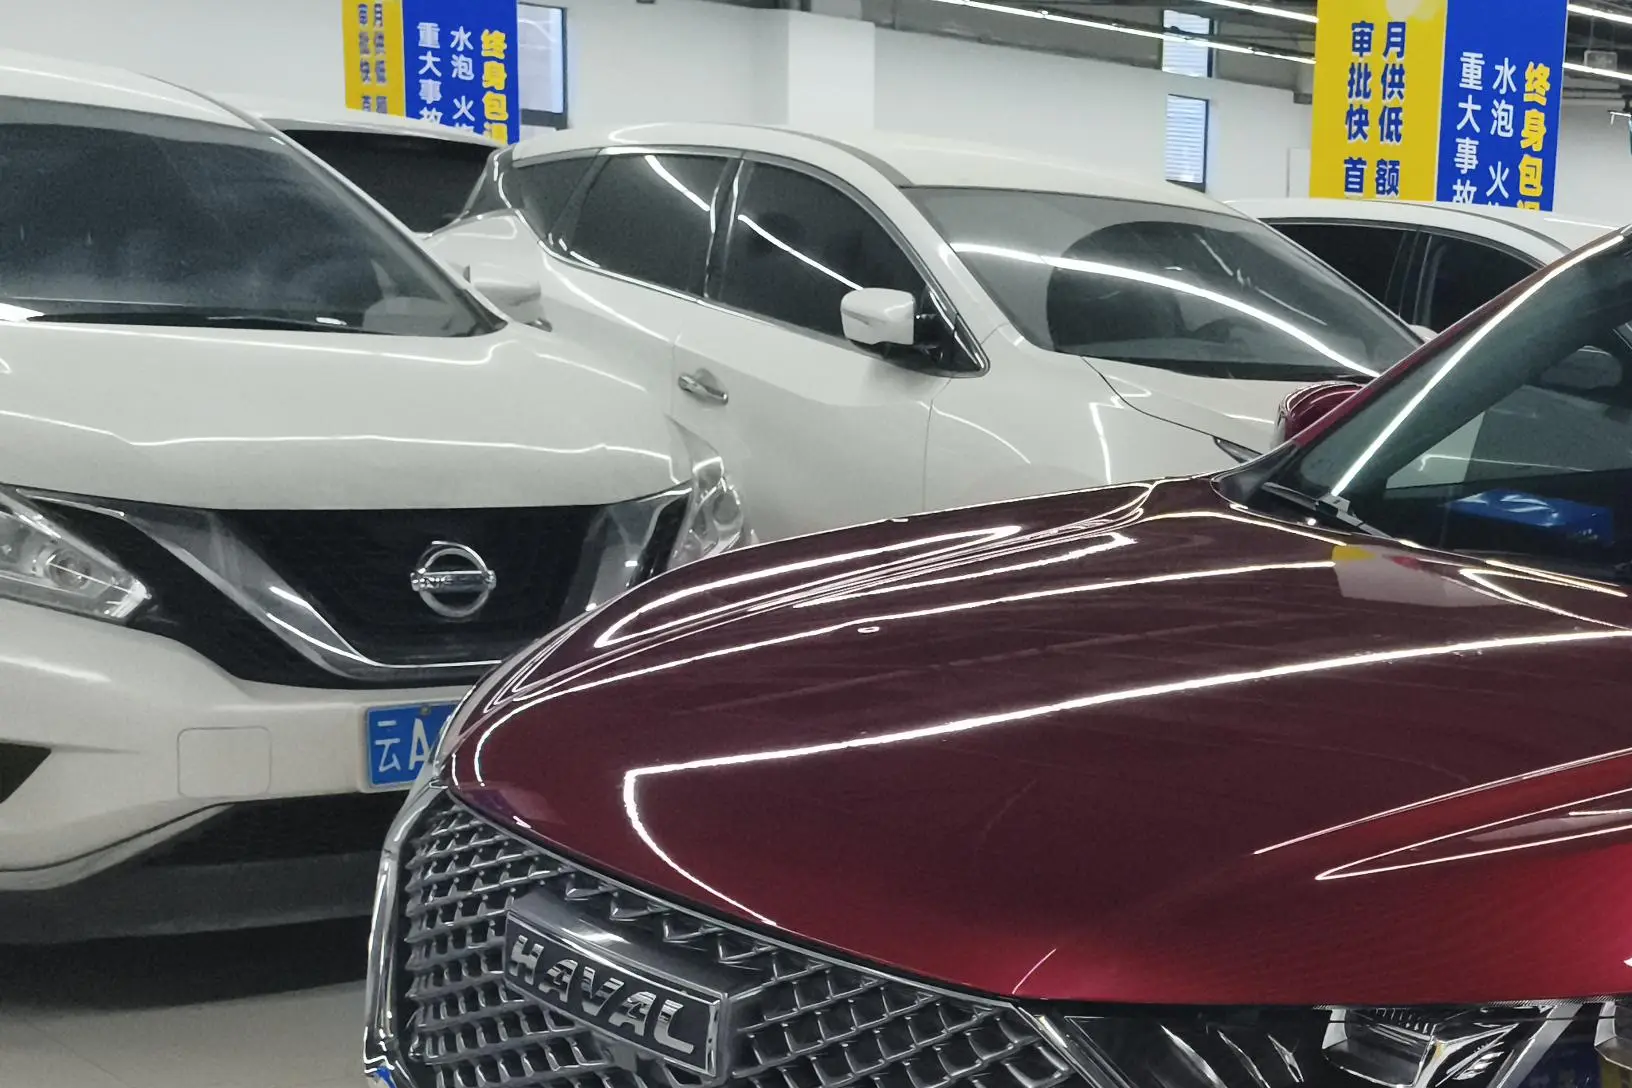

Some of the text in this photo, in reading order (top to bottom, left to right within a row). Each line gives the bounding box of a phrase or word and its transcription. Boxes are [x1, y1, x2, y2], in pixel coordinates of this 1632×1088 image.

[450, 26, 474, 80] 水泡
[1343, 20, 1374, 195] 审批快 首
[1375, 21, 1406, 197] 月供低 额
[1452, 52, 1485, 204] 重大事故
[1486, 57, 1517, 208] 水泡 火
[1517, 61, 1550, 211] 终身包
[509, 934, 695, 1055] HAVAL
